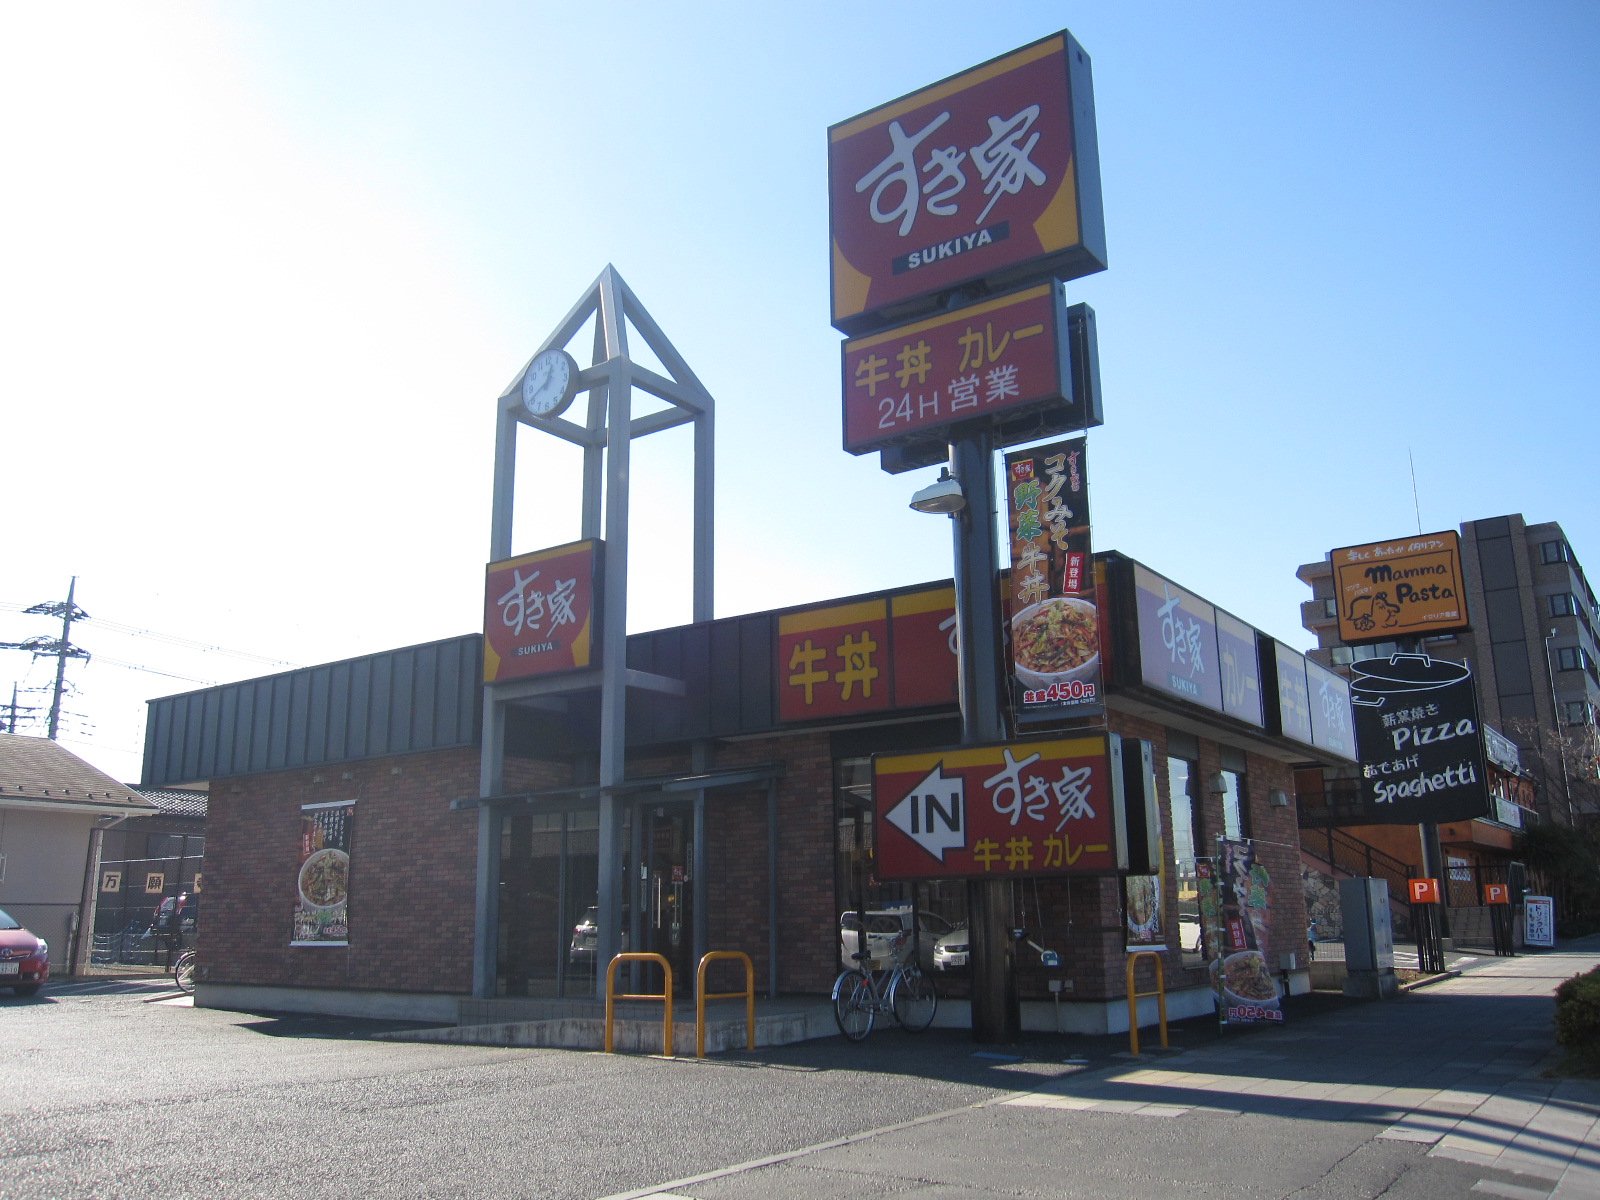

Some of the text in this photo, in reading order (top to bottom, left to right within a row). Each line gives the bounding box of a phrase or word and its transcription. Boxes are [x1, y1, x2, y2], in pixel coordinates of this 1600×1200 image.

[855, 104, 1047, 236] すき家
[908, 229, 992, 269] SUKIYA
[855, 321, 1043, 396] 牛丼 カレー
[1014, 480, 1050, 604] 野菜牛丼
[1068, 556, 1080, 590] 新登場
[1396, 583, 1454, 604] Pasta
[498, 569, 577, 638] すき家
[517, 642, 553, 656] SUKIYA
[1157, 582, 1205, 680] すき家
[789, 630, 879, 705] 牛丼
[1171, 674, 1199, 696] SUKIYA
[1221, 643, 1258, 707] カレー
[1319, 670, 1347, 738] すき家
[1392, 718, 1475, 750] Pizza
[1363, 753, 1419, 779] 茹であげ
[1373, 761, 1477, 804] Spaghetti
[984, 748, 1096, 832] すき家
[911, 792, 960, 834] IN
[973, 833, 1109, 871] 牛丼 カレー
[105, 875, 161, 890] 万 願
[1414, 882, 1428, 900] P
[1489, 887, 1500, 900] P
